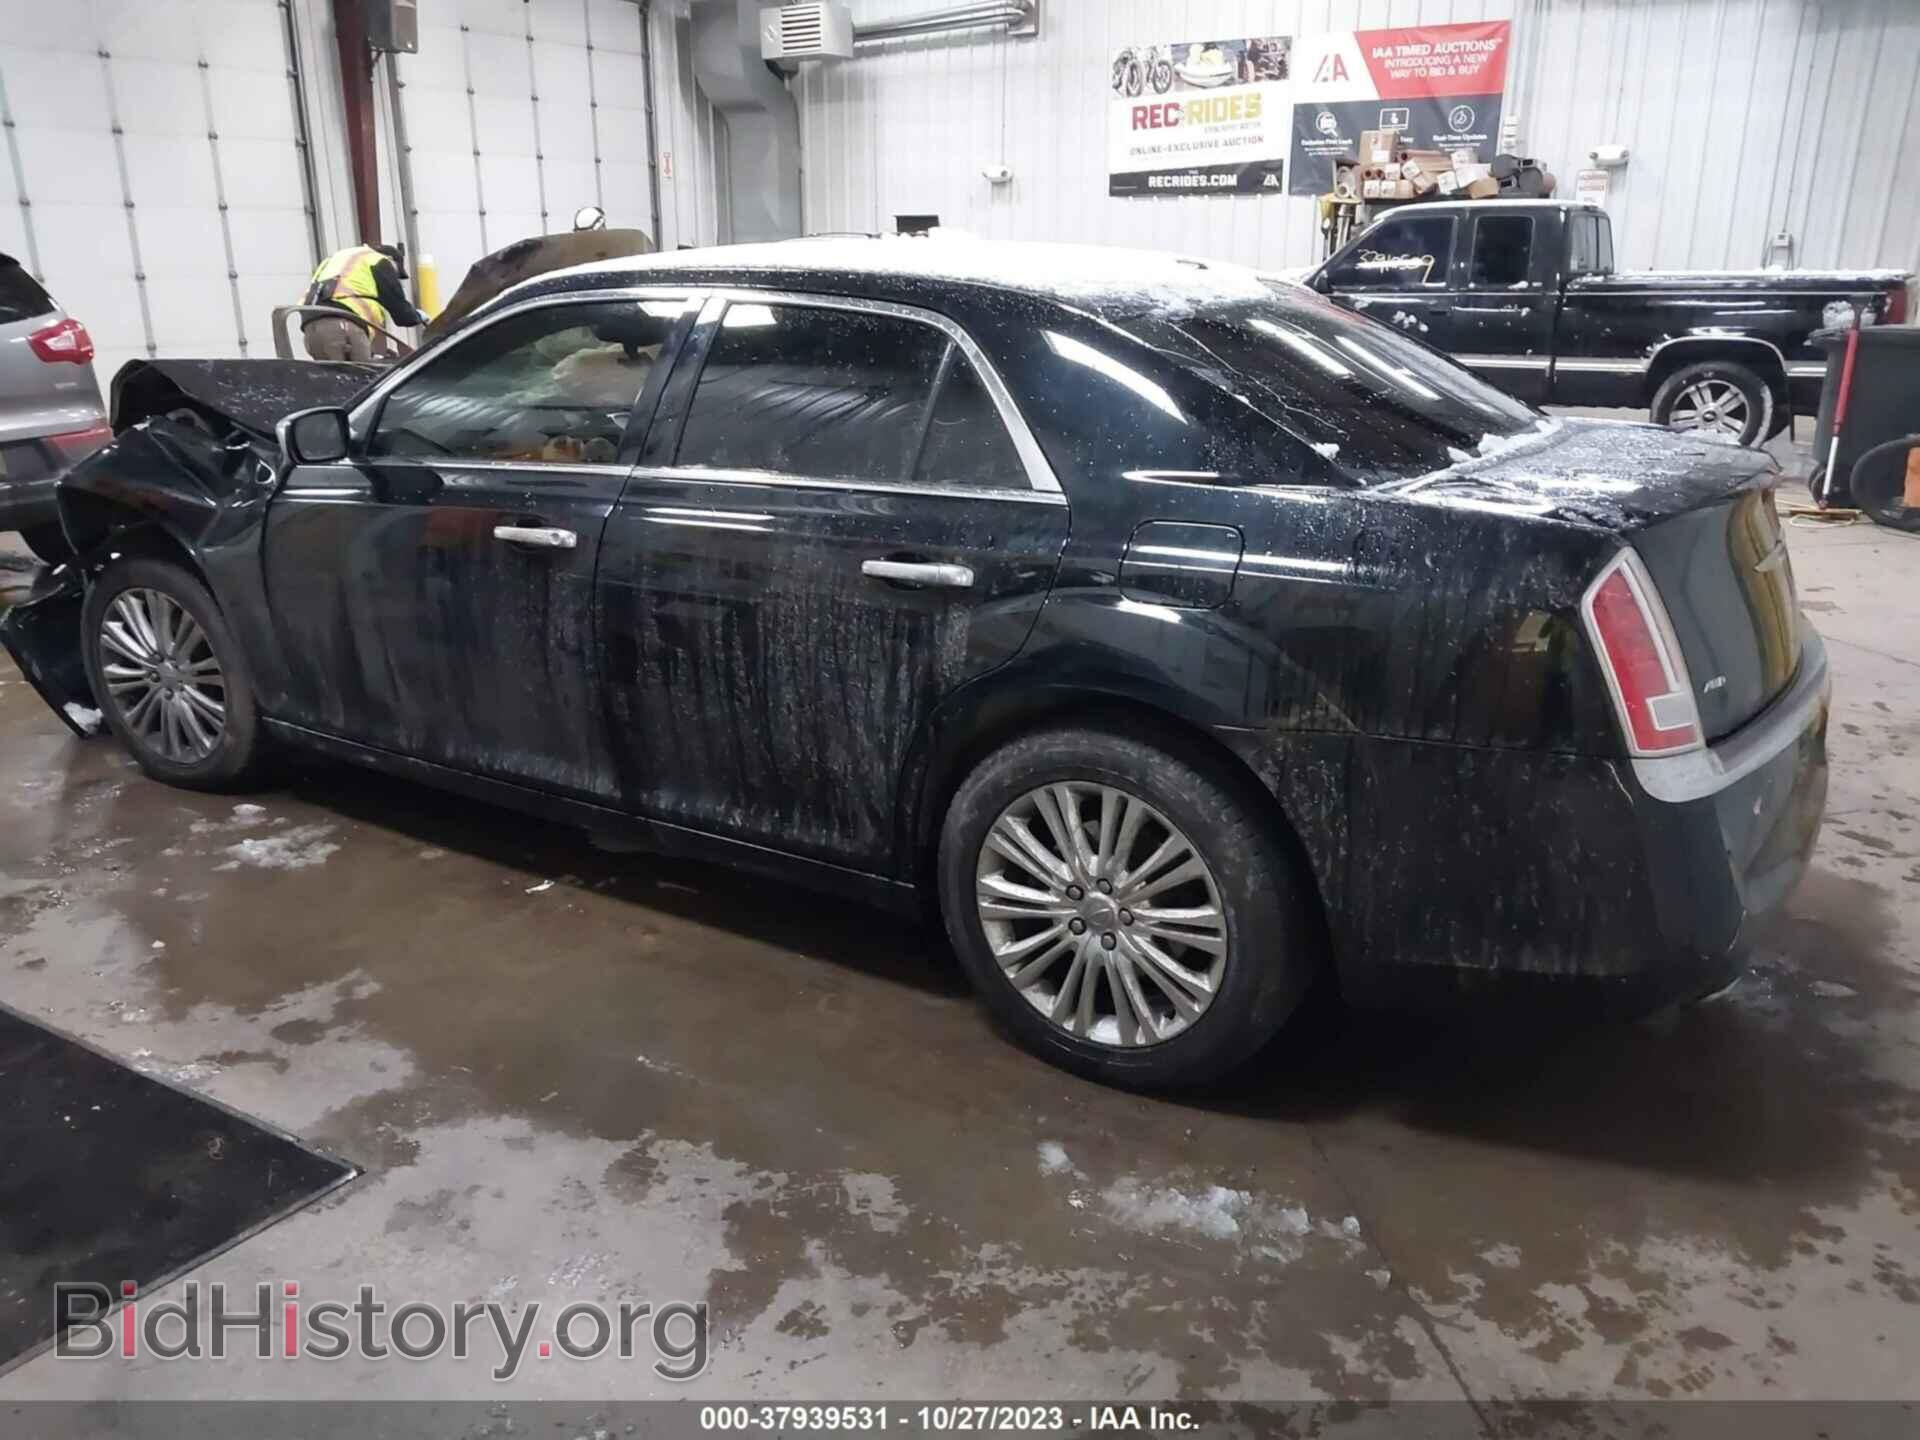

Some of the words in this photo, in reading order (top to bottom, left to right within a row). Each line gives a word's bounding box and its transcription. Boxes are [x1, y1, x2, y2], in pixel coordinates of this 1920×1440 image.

[1396, 45, 1431, 56] TIMED
[1384, 56, 1451, 68] INTRODUCING
[1453, 55, 1461, 64] A
[1464, 53, 1488, 64] NEW
[1390, 69, 1411, 79] WAY
[1414, 68, 1426, 77] TO
[1459, 65, 1480, 75] BUY
[1132, 102, 1180, 130] REC
[1187, 93, 1262, 125] RIDES
[1222, 135, 1264, 147] AUCTION
[1148, 174, 1237, 188] RECRIDES.COM
